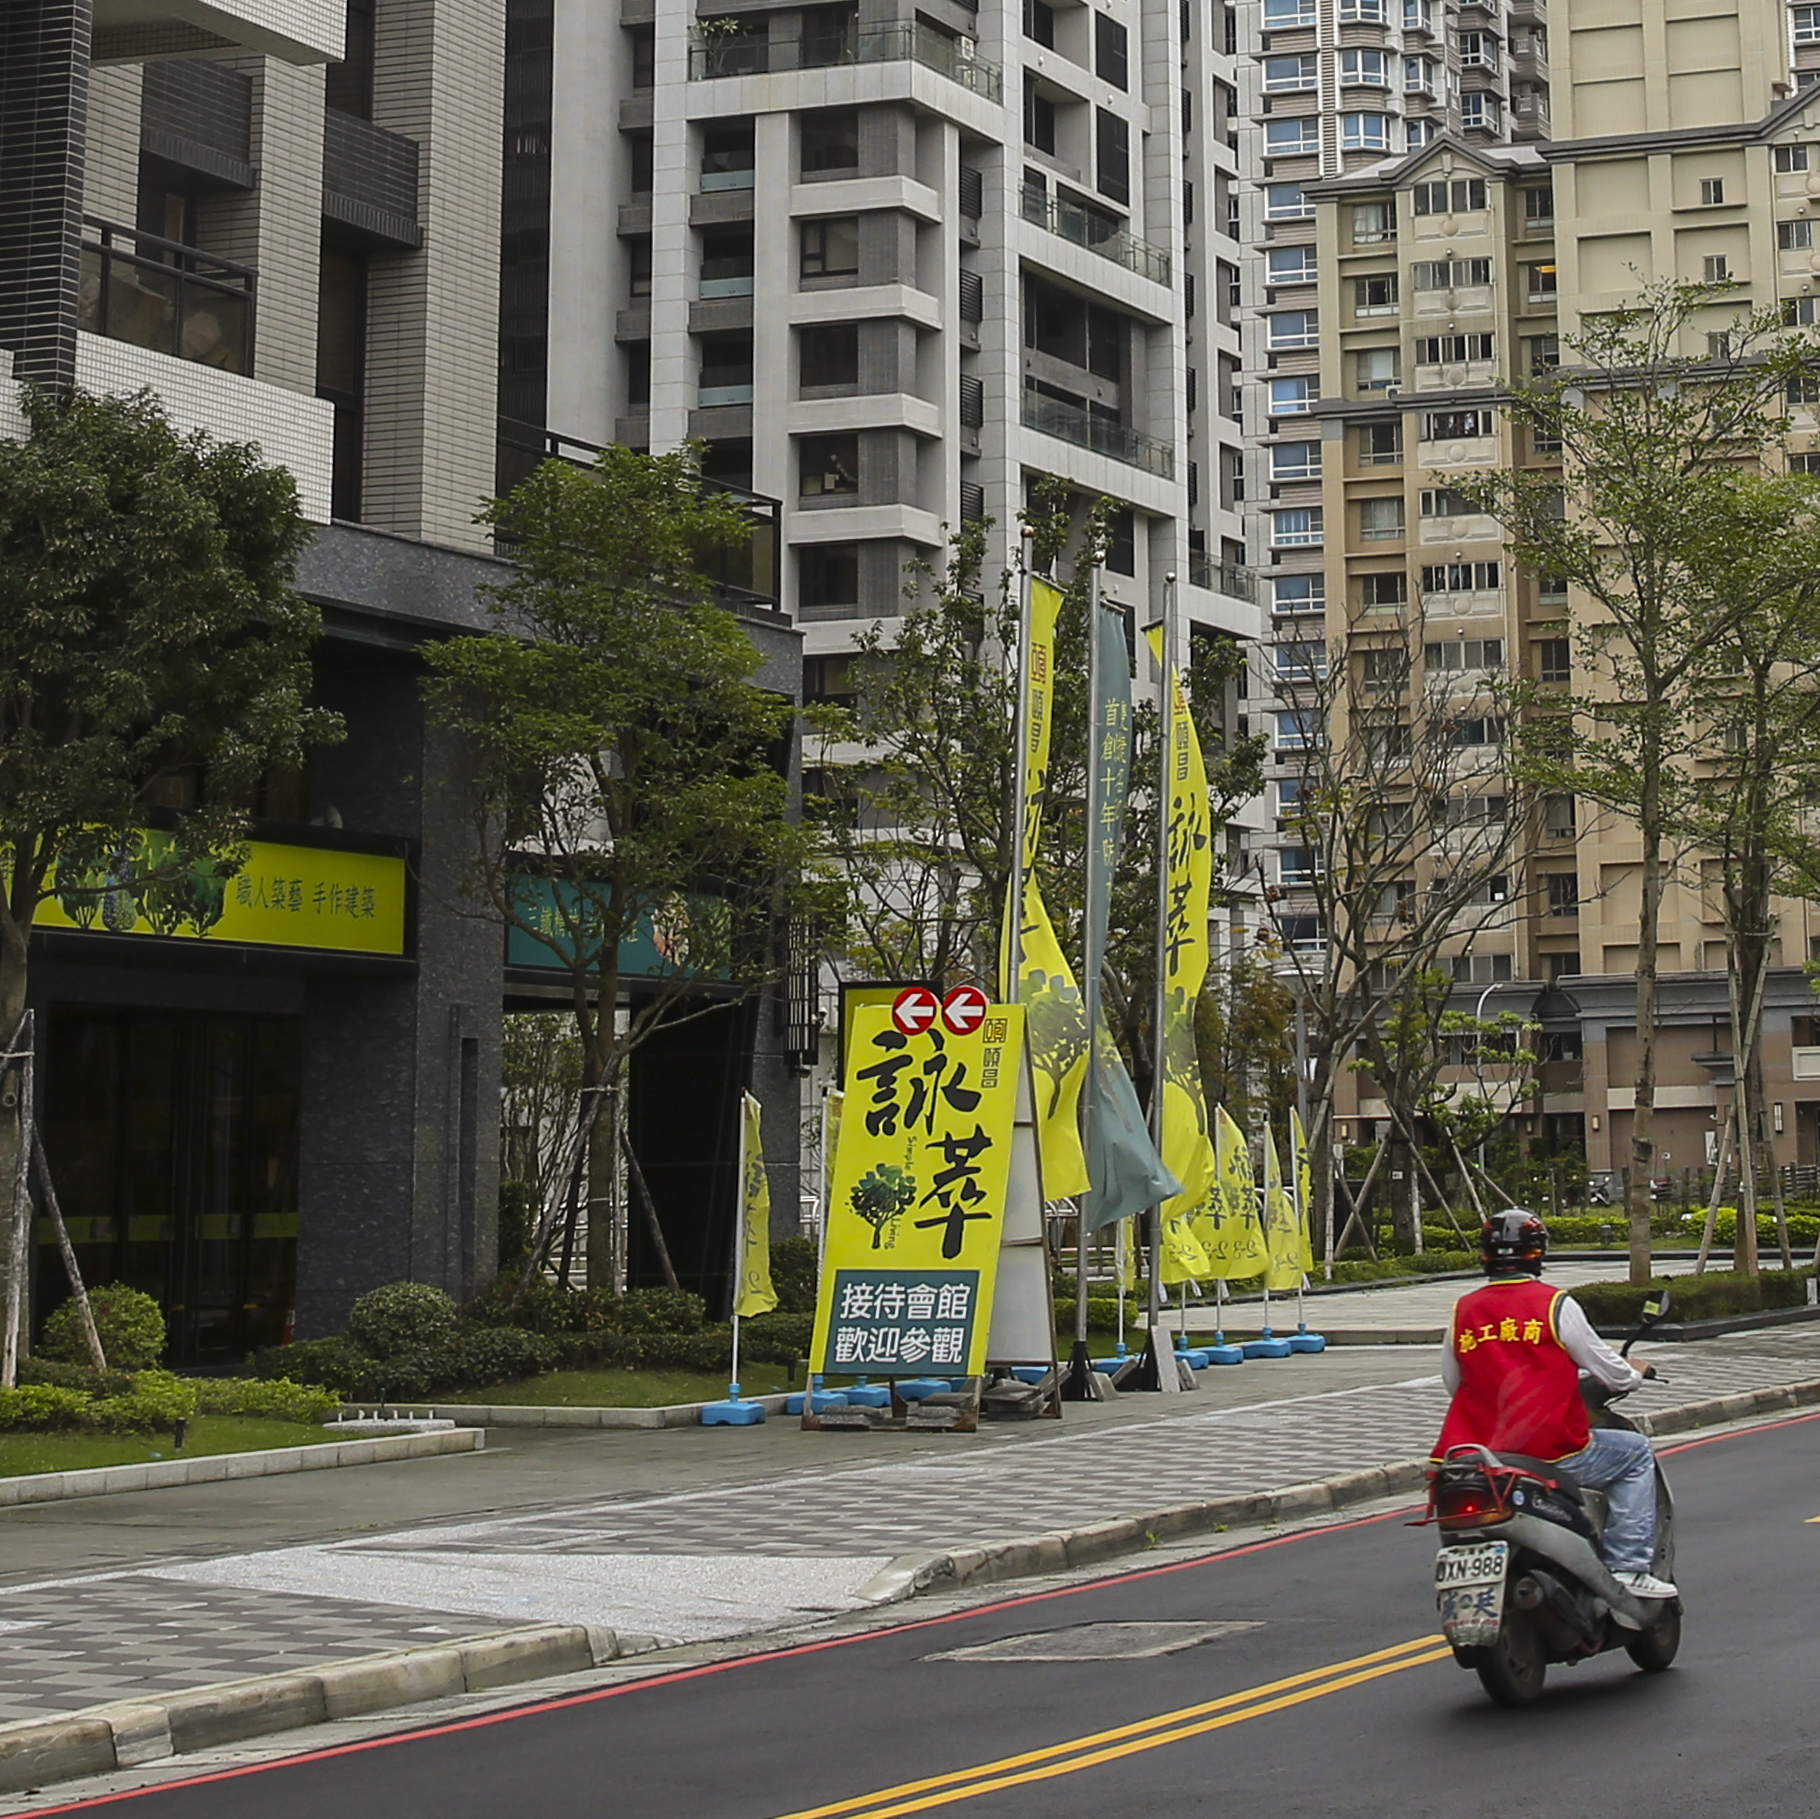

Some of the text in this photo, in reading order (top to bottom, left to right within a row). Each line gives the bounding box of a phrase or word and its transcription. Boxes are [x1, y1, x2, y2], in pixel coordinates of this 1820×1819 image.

[312, 881, 376, 919] 手作建築
[855, 1028, 994, 1261] 詠萃
[840, 1283, 971, 1320] 接待會館
[835, 1327, 964, 1364] 歡迎參觀
[1458, 1317, 1544, 1353] 施工廠商
